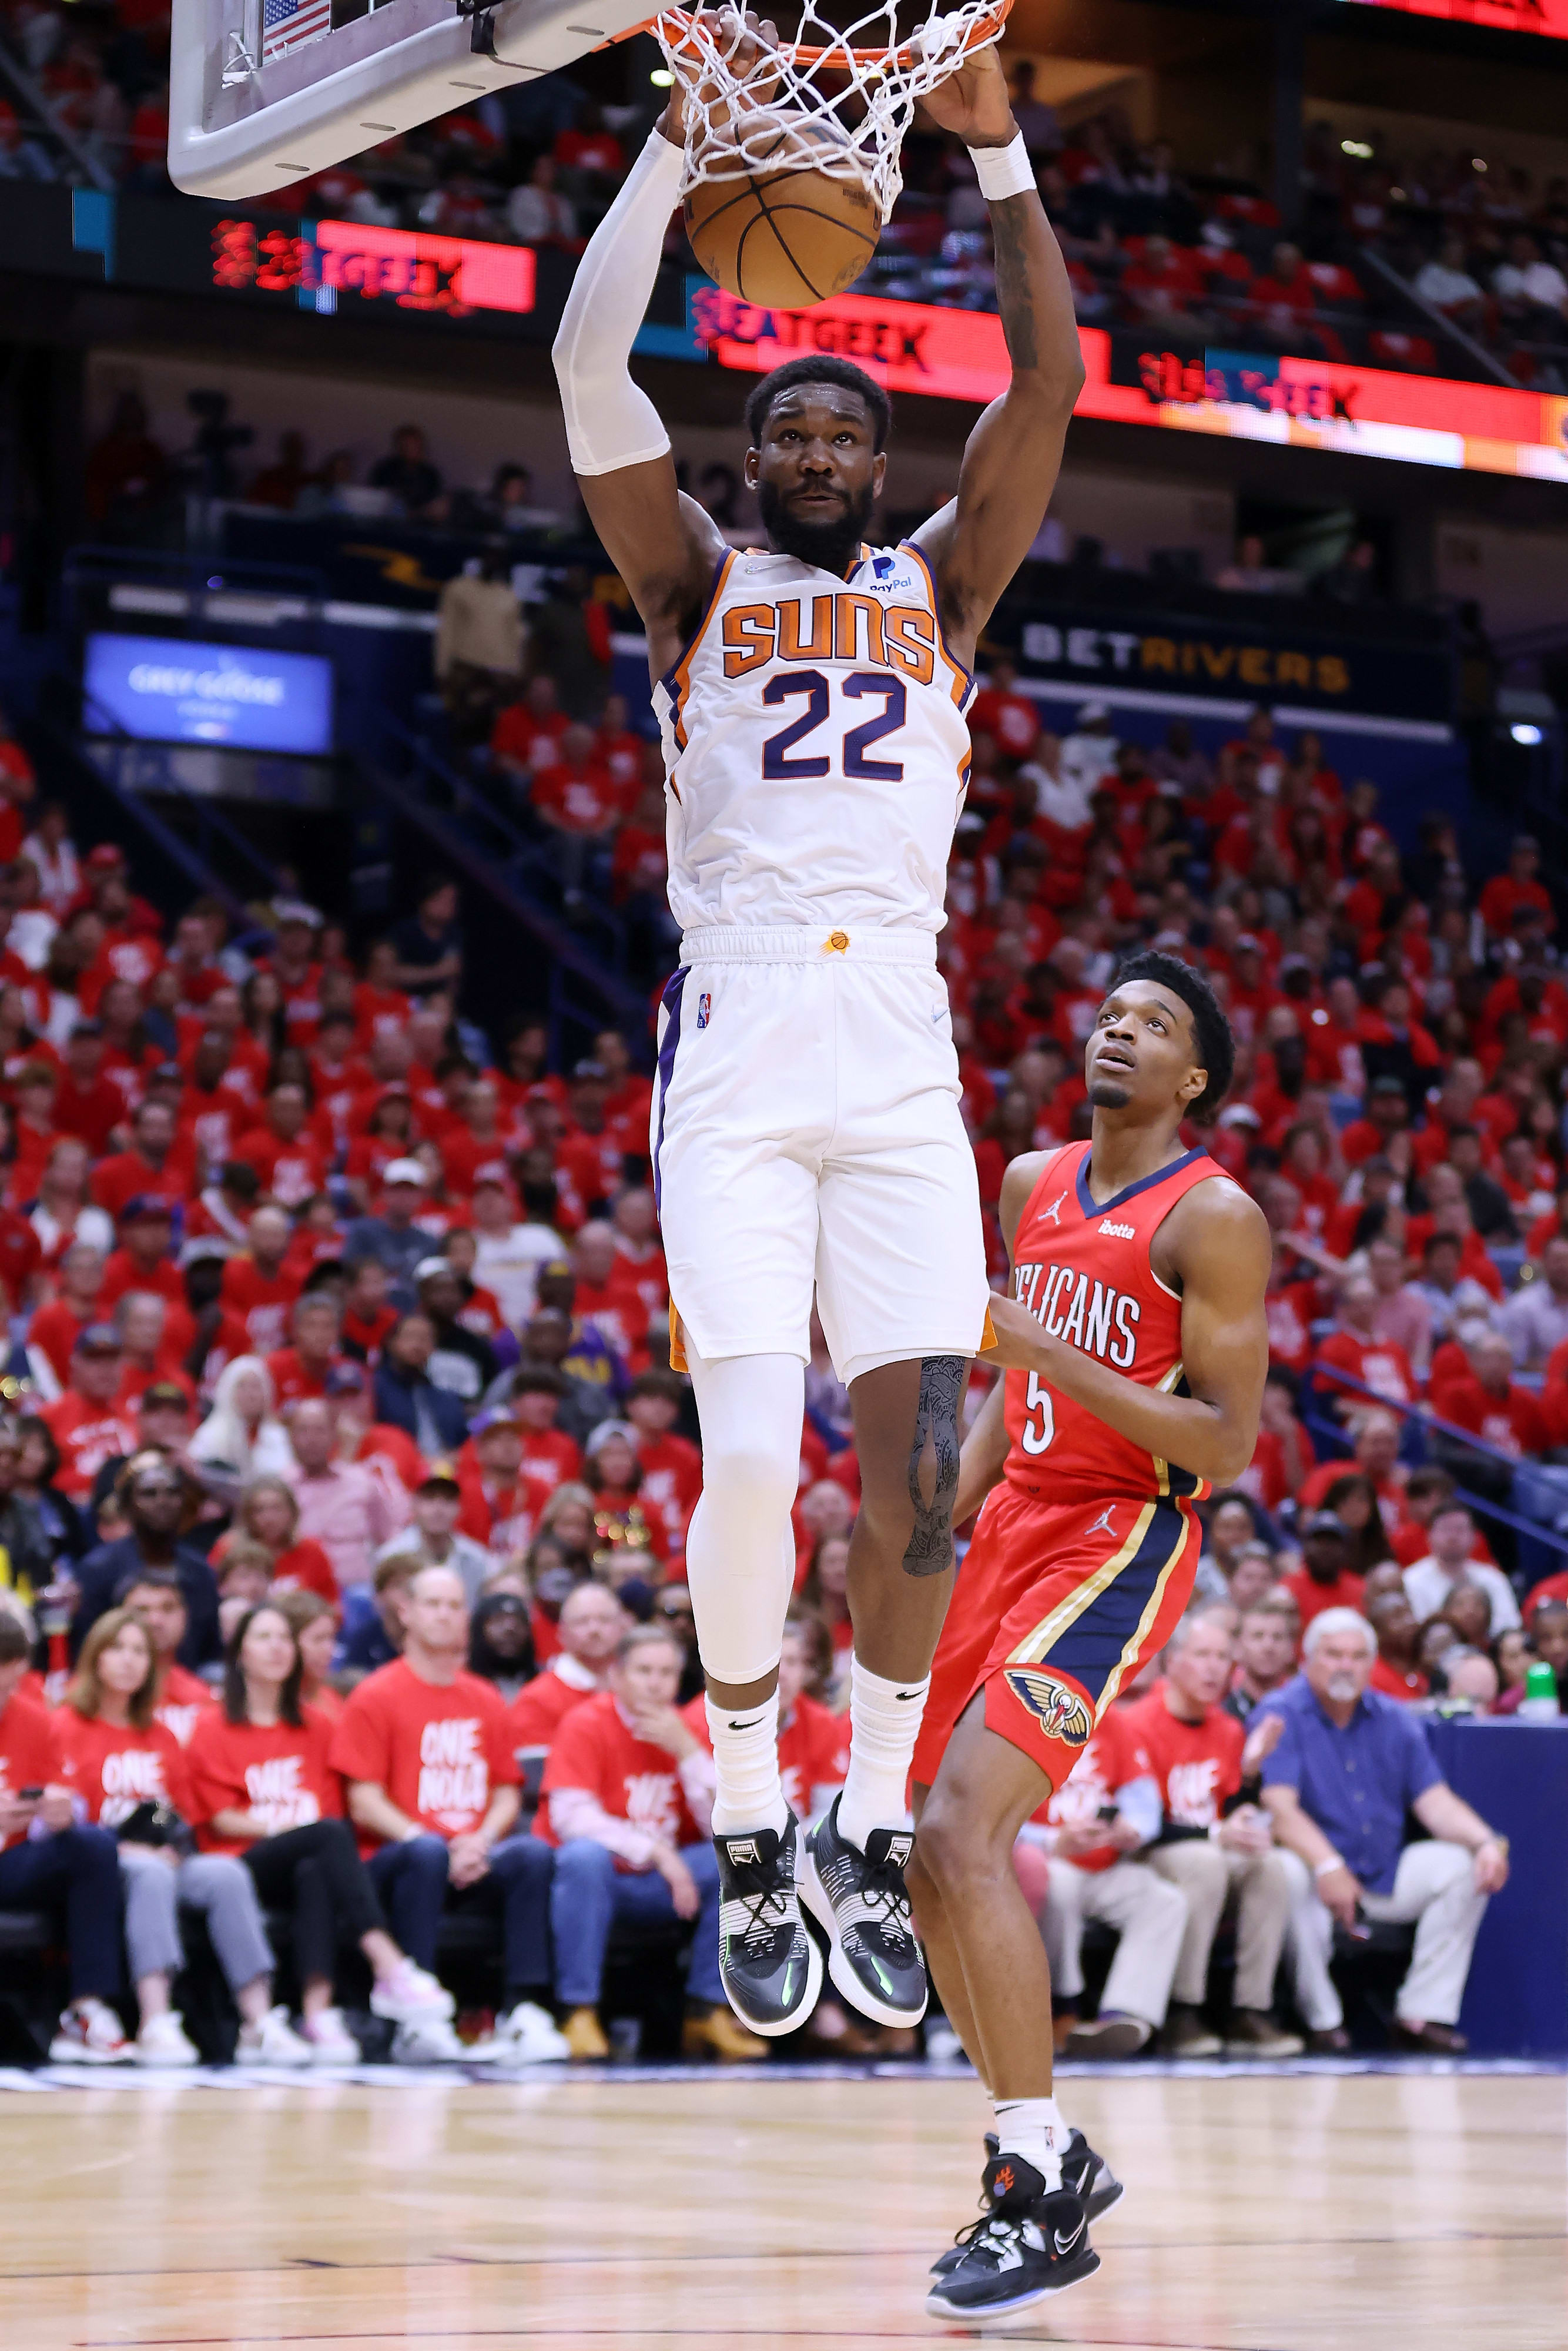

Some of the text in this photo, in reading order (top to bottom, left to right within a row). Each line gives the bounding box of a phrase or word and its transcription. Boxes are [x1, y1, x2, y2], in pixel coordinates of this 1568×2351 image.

[722, 592, 936, 686] SUNS
[762, 668, 907, 783] 22
[1097, 1218, 1135, 1241] ibotta
[1022, 1370, 1055, 1455] 5
[419, 1719, 482, 1765] ONE
